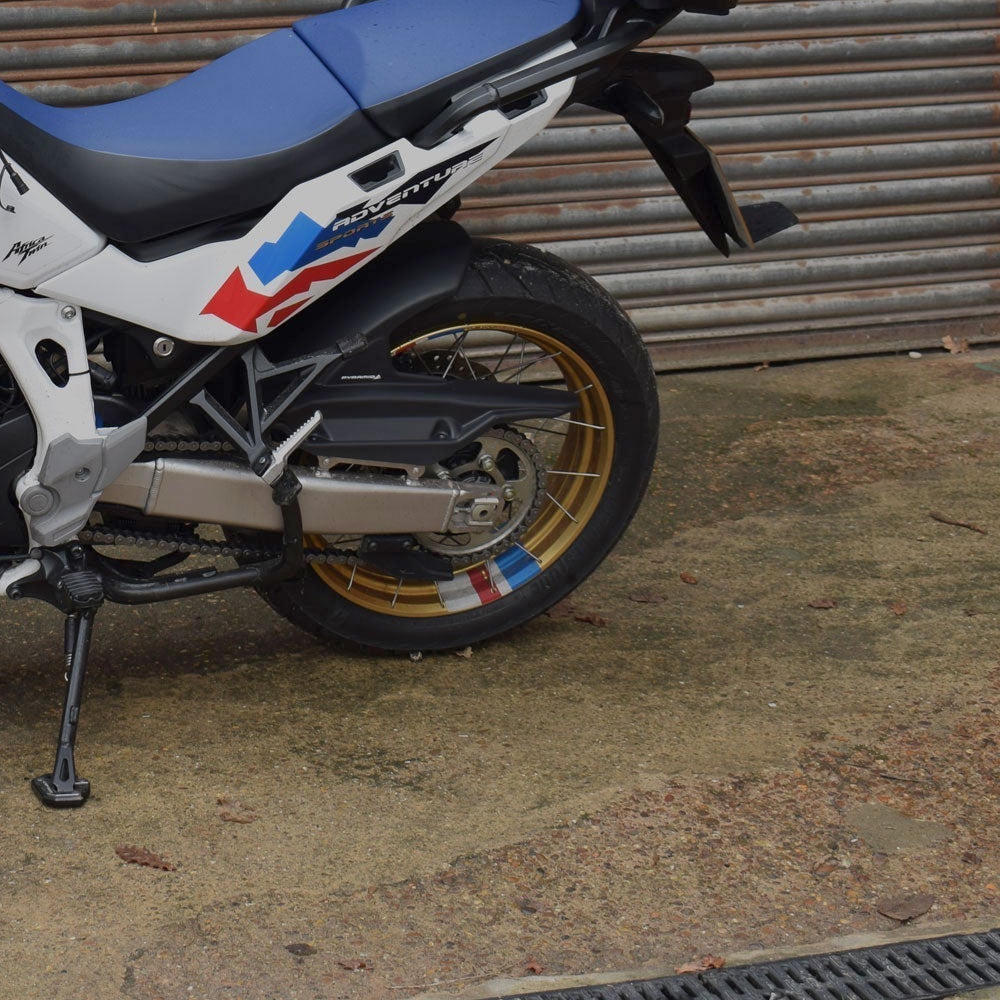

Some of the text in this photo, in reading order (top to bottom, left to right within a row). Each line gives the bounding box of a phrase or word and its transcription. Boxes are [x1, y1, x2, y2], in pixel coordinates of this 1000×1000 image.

[332, 152, 484, 232] ADVENTURE
[315, 210, 395, 250] SPORTS
[1, 235, 47, 262] Africa
[18, 241, 49, 266] Twin
